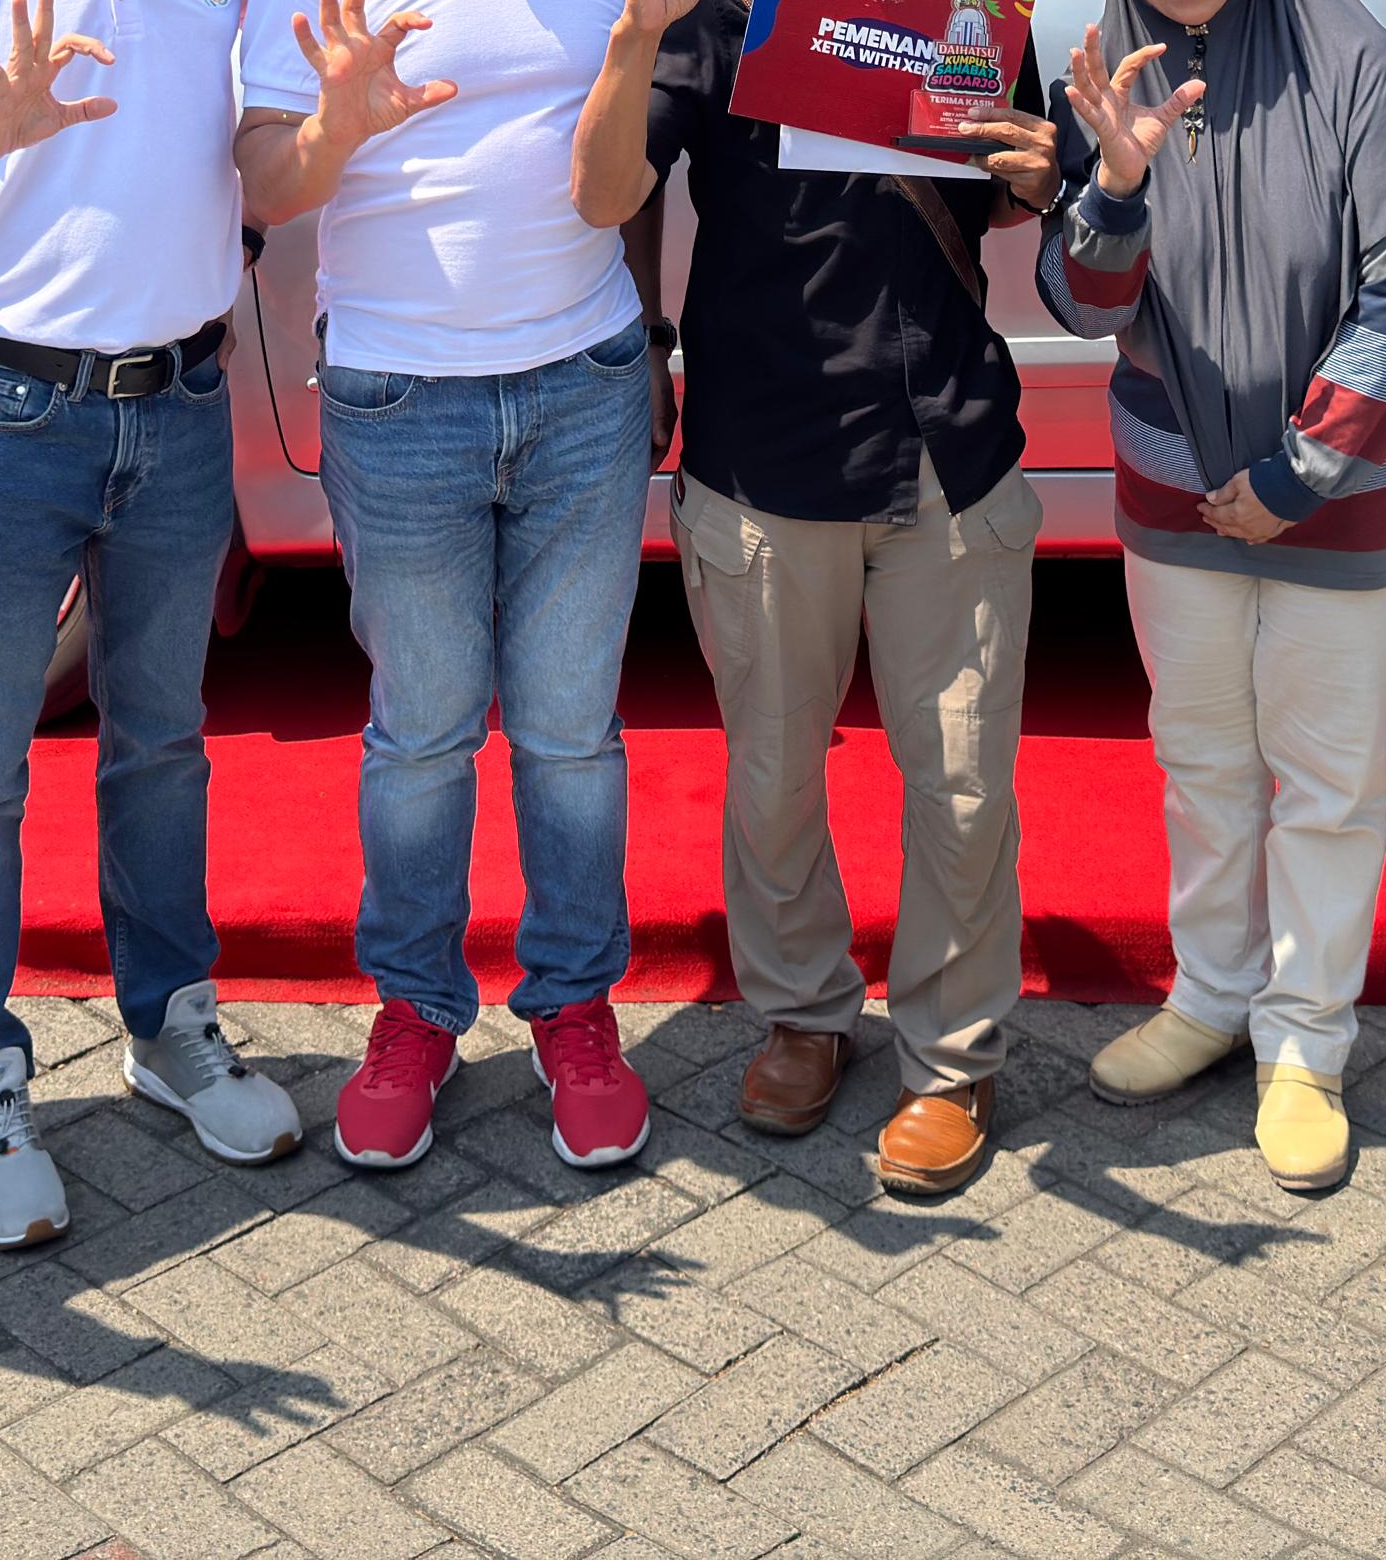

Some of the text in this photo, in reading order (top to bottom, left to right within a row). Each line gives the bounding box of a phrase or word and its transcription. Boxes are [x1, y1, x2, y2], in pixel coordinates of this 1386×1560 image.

[810, 37, 930, 76] XETIA WITH XEN
[939, 44, 996, 58] DAIHATSU
[945, 55, 989, 68] KUMPUL
[935, 64, 996, 79] SAHABAT
[930, 75, 998, 89] SIDOARJO
[930, 95, 995, 108] TERIMA KASIH
